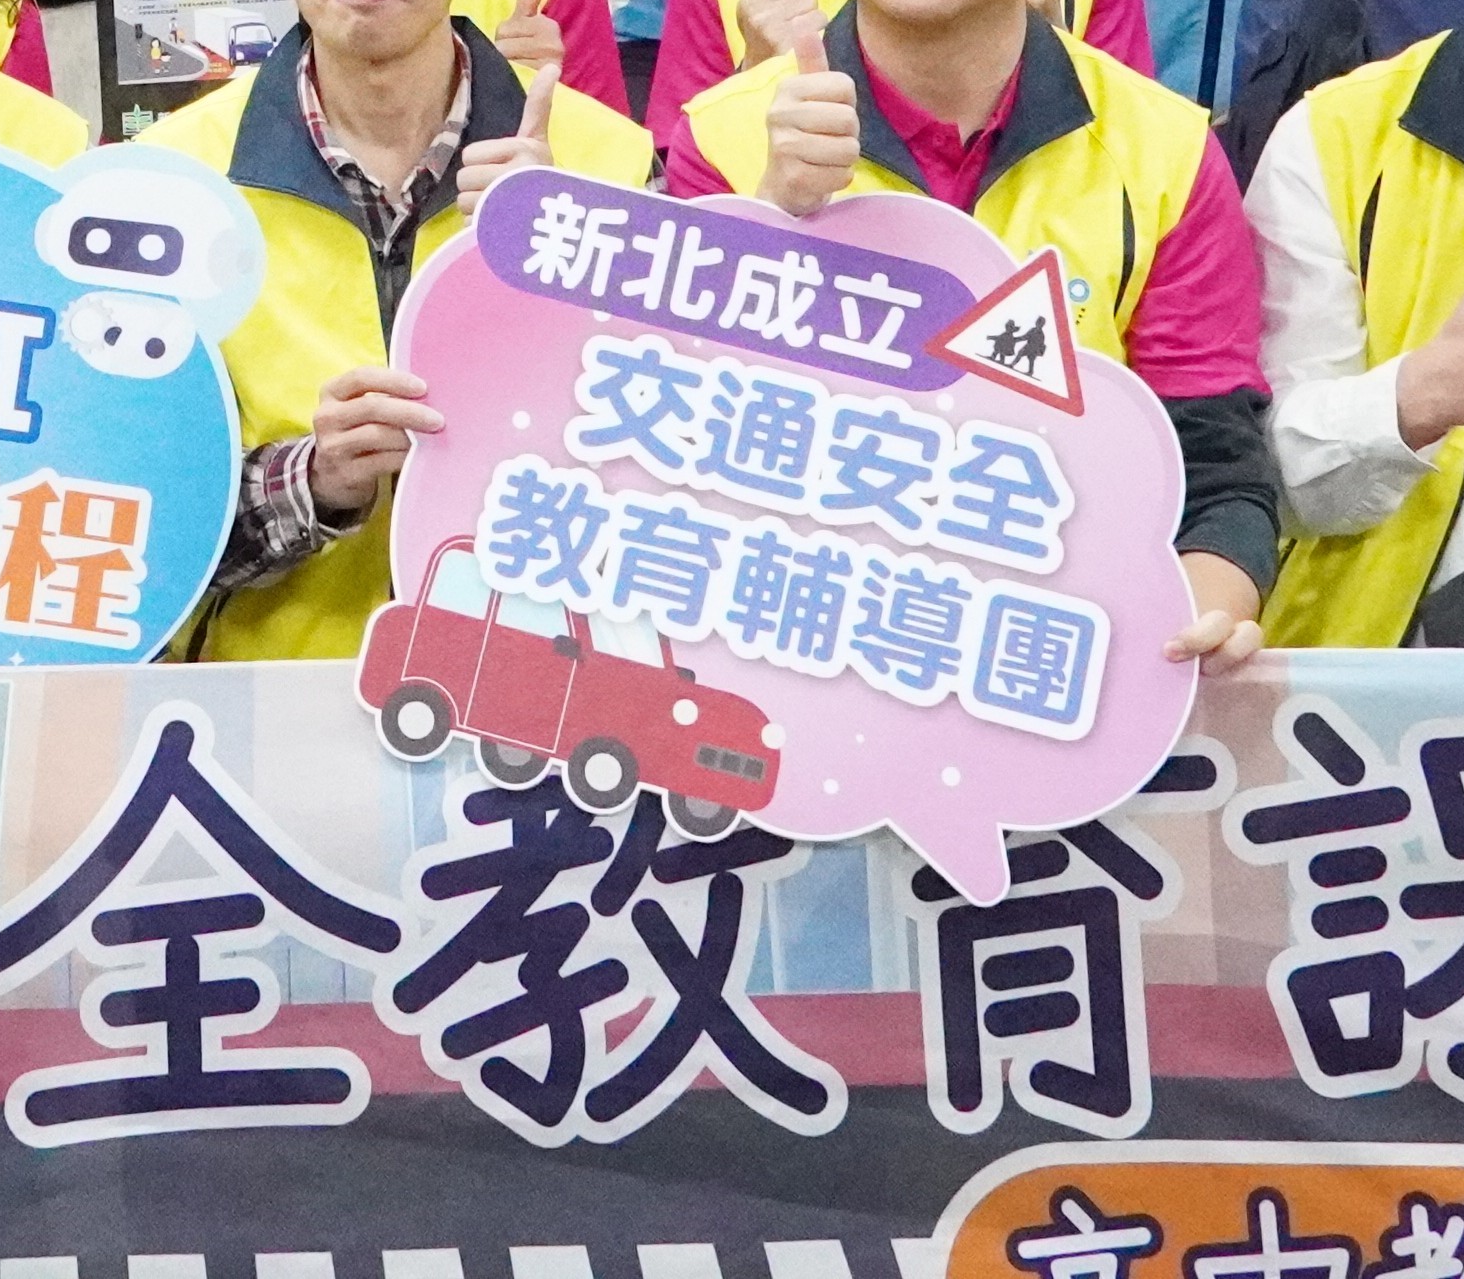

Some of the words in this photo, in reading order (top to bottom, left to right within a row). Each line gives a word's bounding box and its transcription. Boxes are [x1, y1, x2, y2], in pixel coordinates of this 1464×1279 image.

[523, 192, 924, 372] 新北成立
[578, 346, 1063, 563] 交通安全
[488, 469, 1098, 729] 教育輔導團
